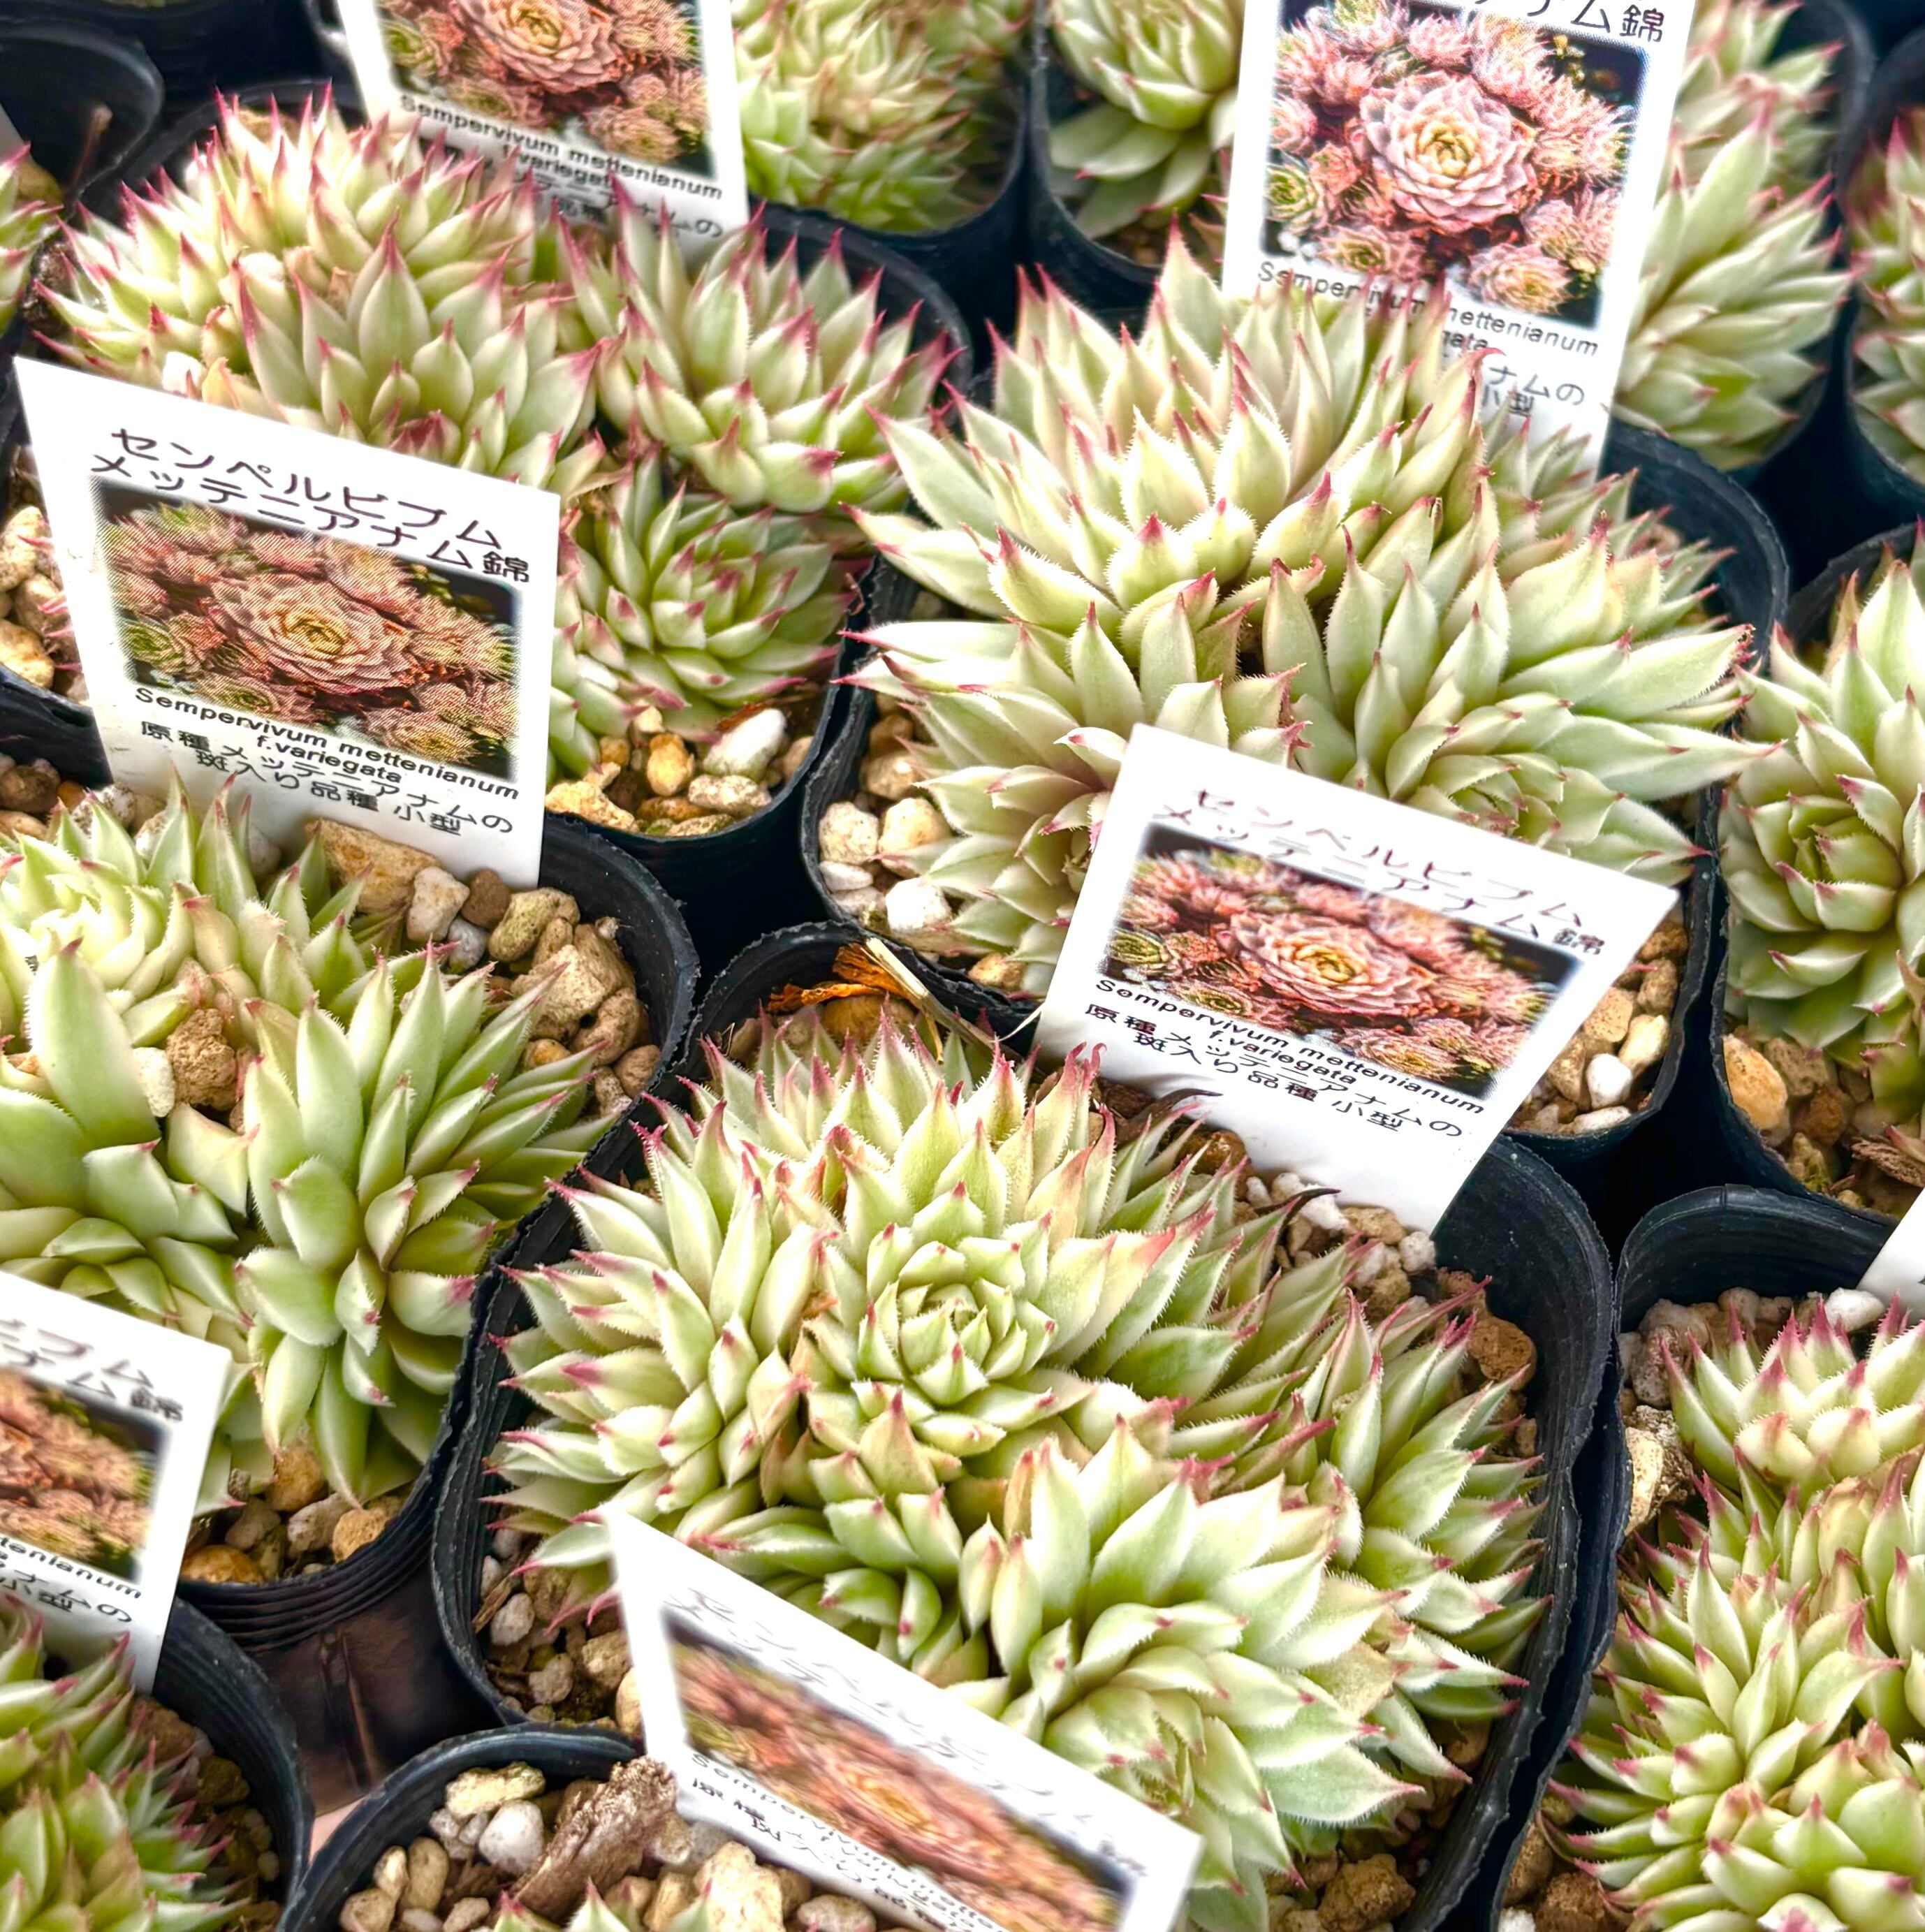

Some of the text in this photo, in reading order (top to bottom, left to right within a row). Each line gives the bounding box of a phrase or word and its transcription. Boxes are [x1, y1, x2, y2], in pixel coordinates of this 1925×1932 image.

[401, 93, 723, 200] Sempervivum mettenianum
[90, 454, 529, 583] メッテニアナム錦
[135, 687, 520, 800] Sempervivum mettenianum
[256, 734, 402, 784] f.variegata
[1095, 979, 1485, 1114] Sempervivum mettenianum
[1209, 1030, 1357, 1085] f.variegata
